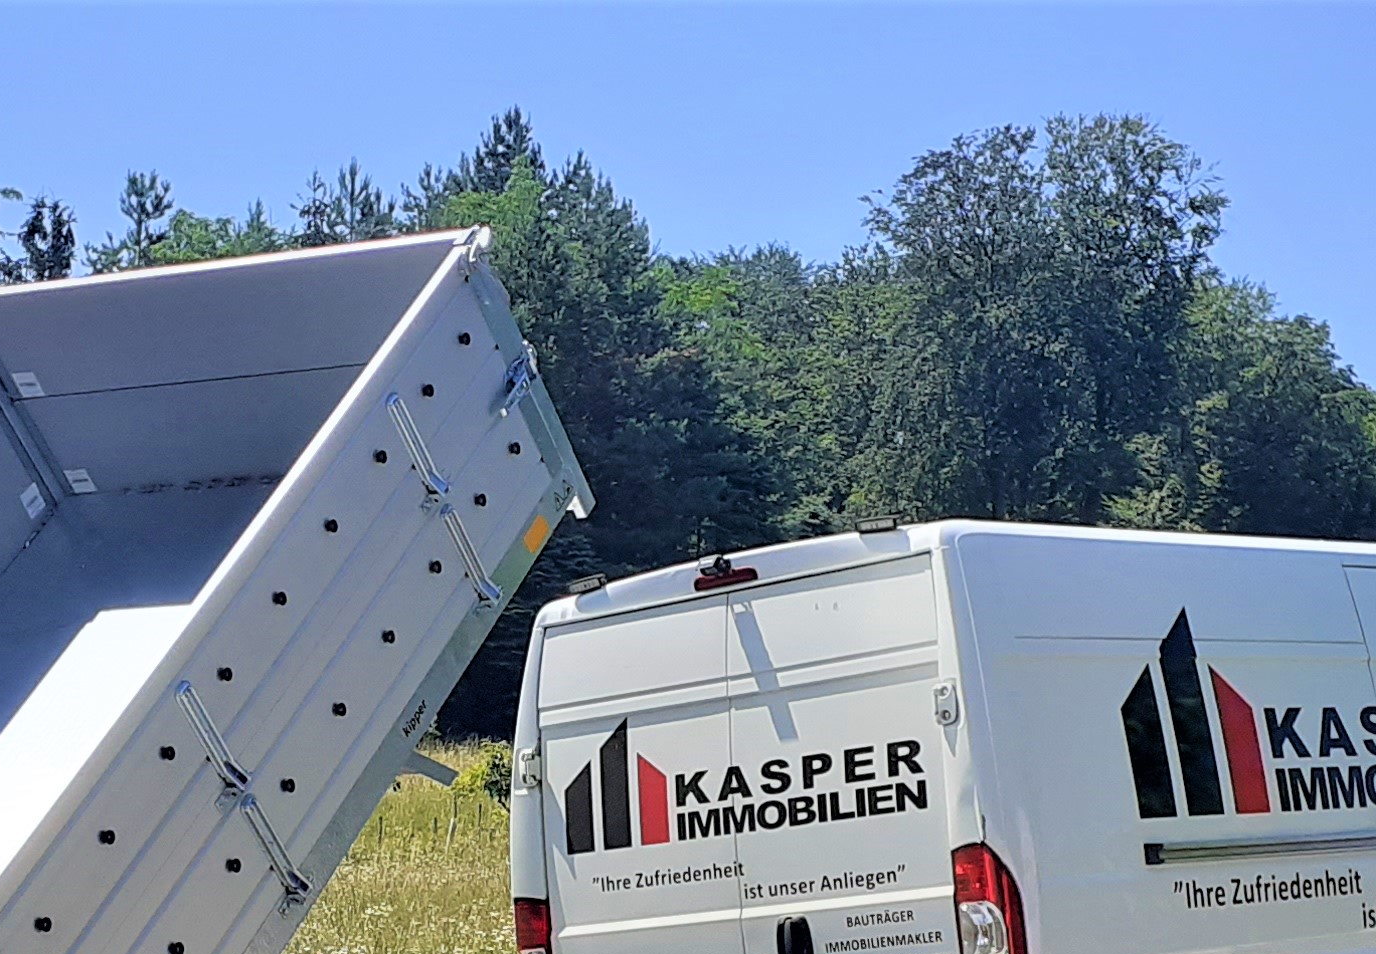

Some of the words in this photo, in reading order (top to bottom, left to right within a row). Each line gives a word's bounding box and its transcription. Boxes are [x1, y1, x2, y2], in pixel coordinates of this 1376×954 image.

[402, 699, 427, 738] kipper
[675, 739, 924, 807] KASPER
[677, 780, 928, 841] IMMOBILIEN
[592, 873, 632, 893] "Ihre
[635, 861, 745, 889] Zufriedenheit
[744, 883, 764, 900] ist
[768, 881, 815, 898] unser
[820, 864, 906, 892] Anliegen"
[1173, 881, 1226, 908] "Ihre
[1230, 869, 1363, 905] Zufriedenheit
[846, 909, 914, 928] BAUTRÄGER
[825, 931, 943, 954] IMMOBILIENMAKLER
